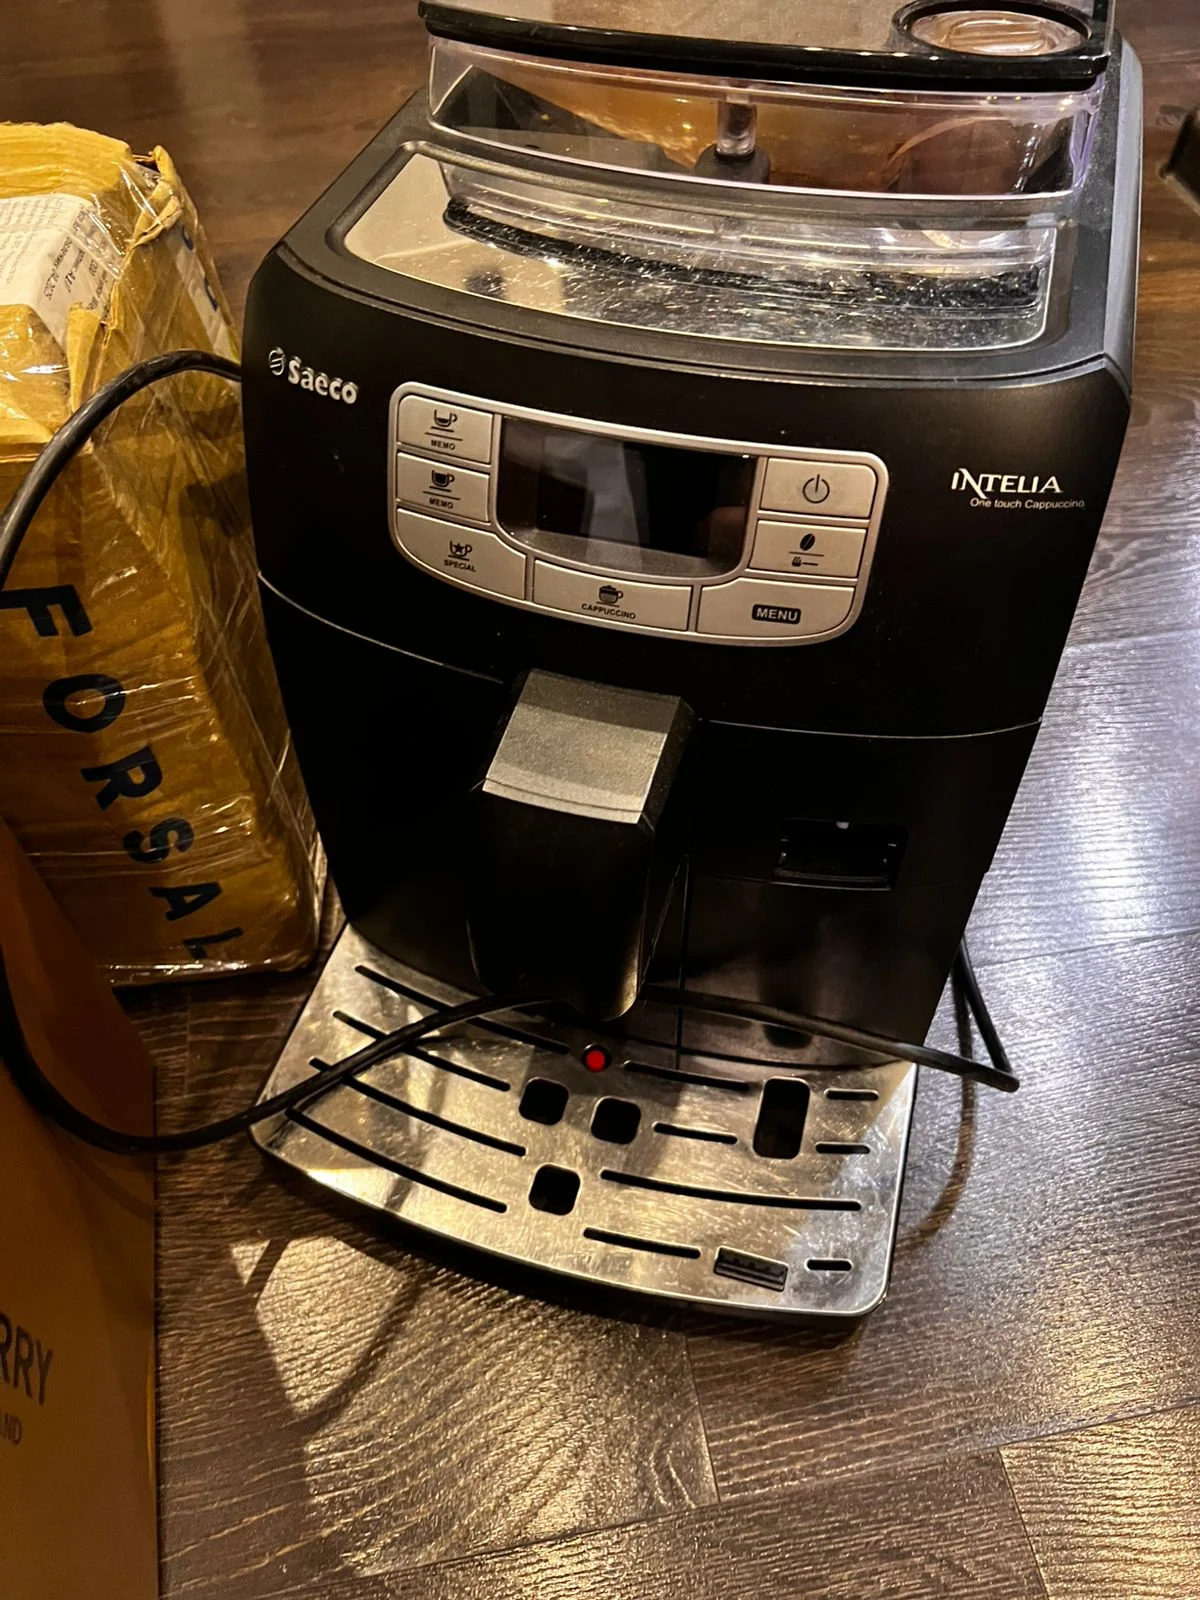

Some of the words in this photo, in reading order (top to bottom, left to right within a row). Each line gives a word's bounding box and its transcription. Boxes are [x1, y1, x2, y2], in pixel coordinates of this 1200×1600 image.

[287, 355, 359, 405] Saeco
[431, 439, 456, 451] MEMO
[951, 468, 1063, 499] INTELIA
[429, 498, 454, 509] MEMO
[970, 497, 992, 507] One
[994, 499, 1022, 508] touch
[1025, 499, 1086, 511] Cappuccino
[444, 559, 476, 572] SPECIAL
[582, 603, 636, 620] CAPPUCCINO
[755, 607, 799, 623] MENU
